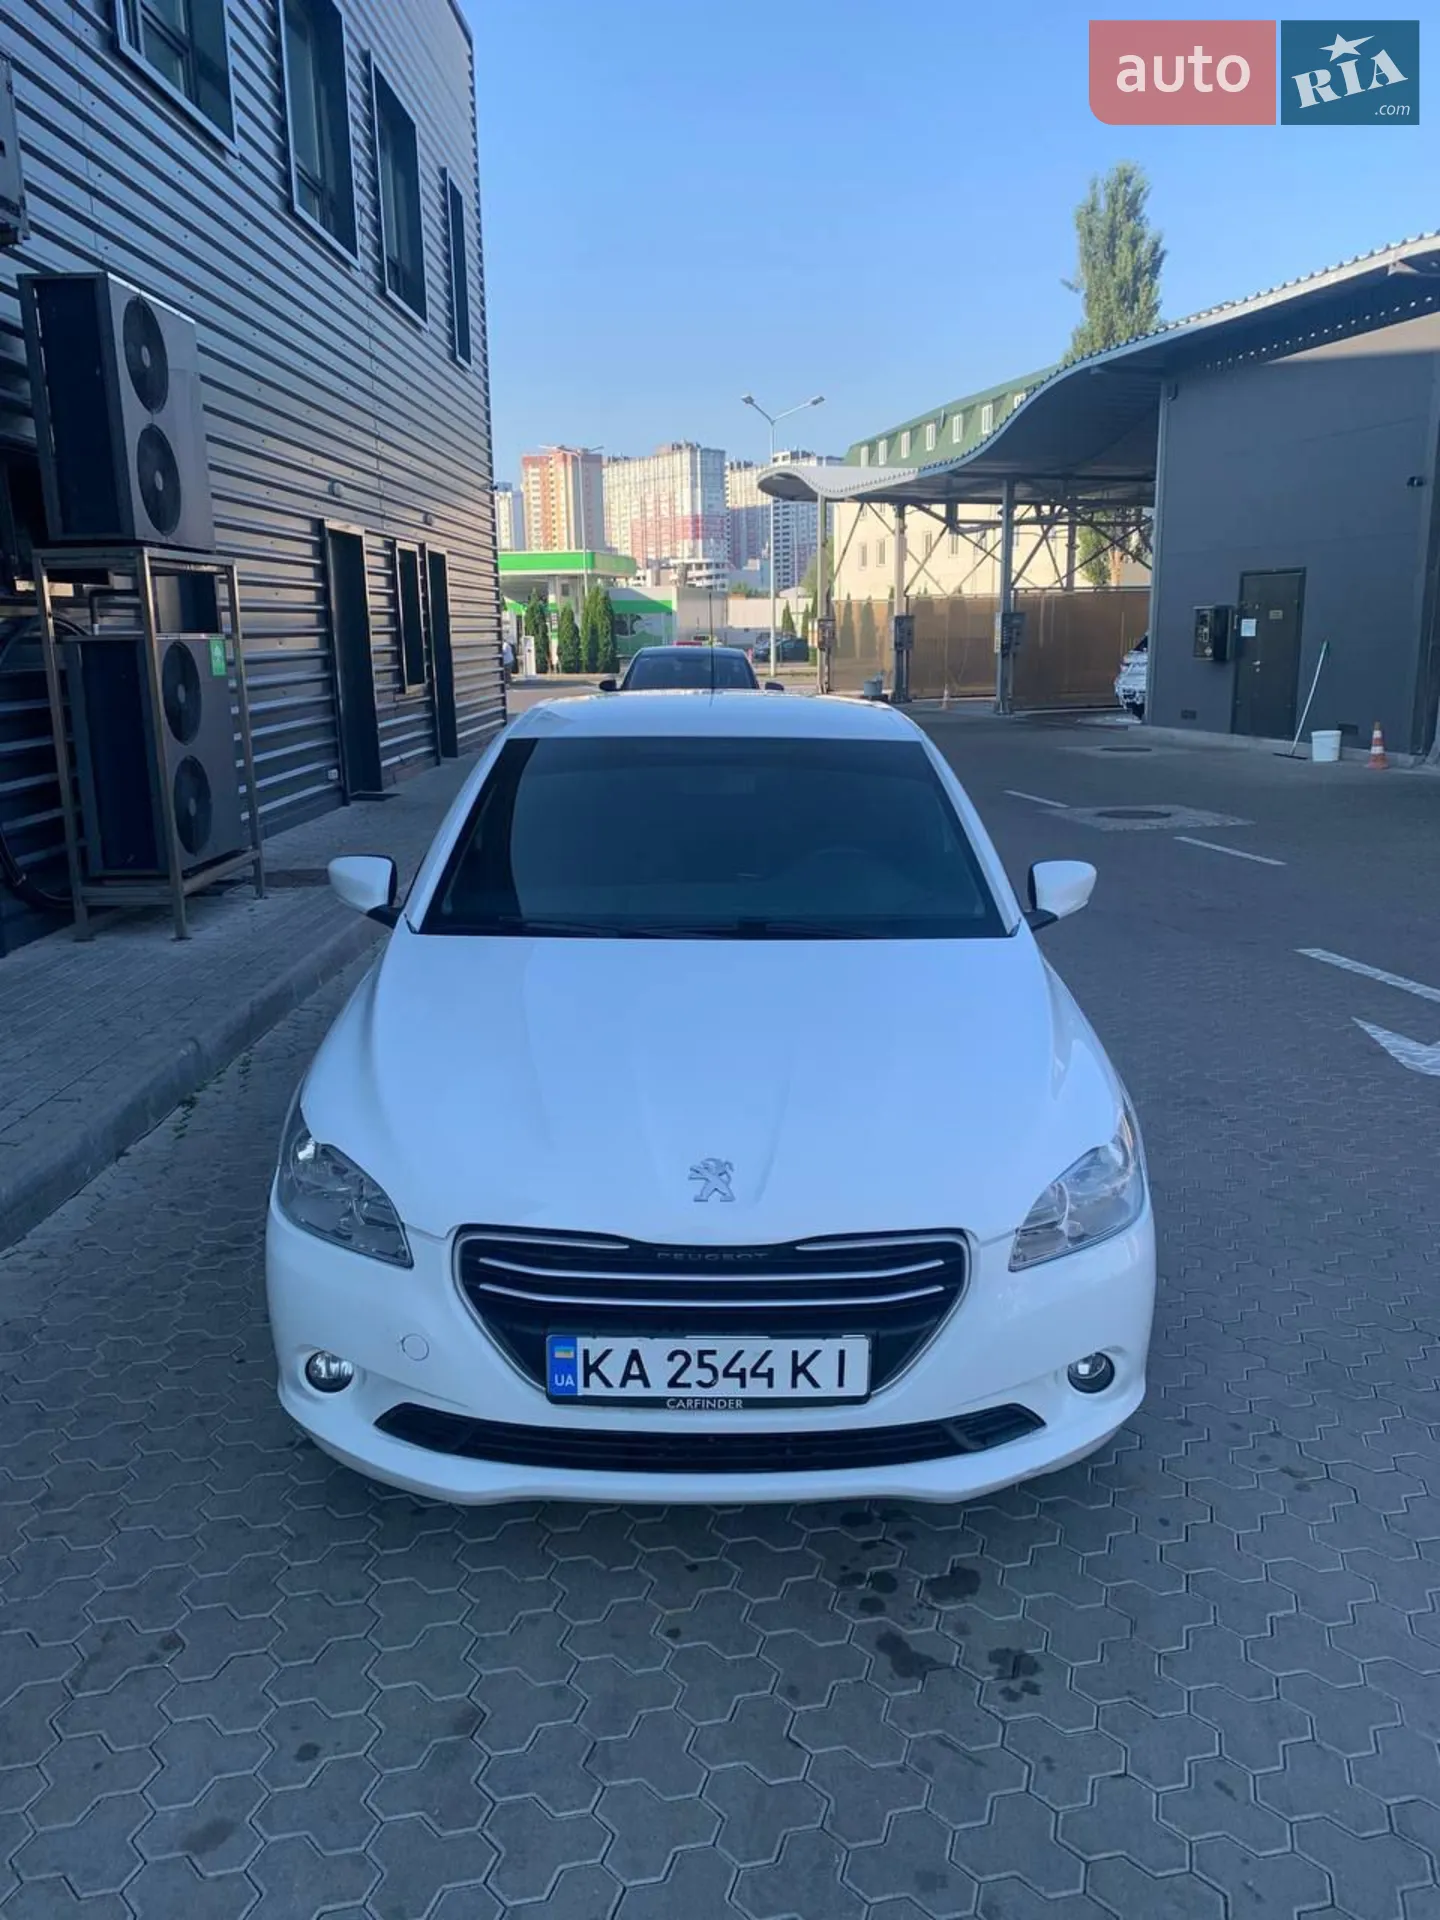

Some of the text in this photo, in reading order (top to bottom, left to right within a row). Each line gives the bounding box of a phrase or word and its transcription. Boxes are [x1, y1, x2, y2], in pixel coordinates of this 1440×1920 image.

[582, 1348, 847, 1389] KA 2544 KI
[554, 1374, 575, 1387] UA
[666, 1398, 744, 1410] CARFINDER
